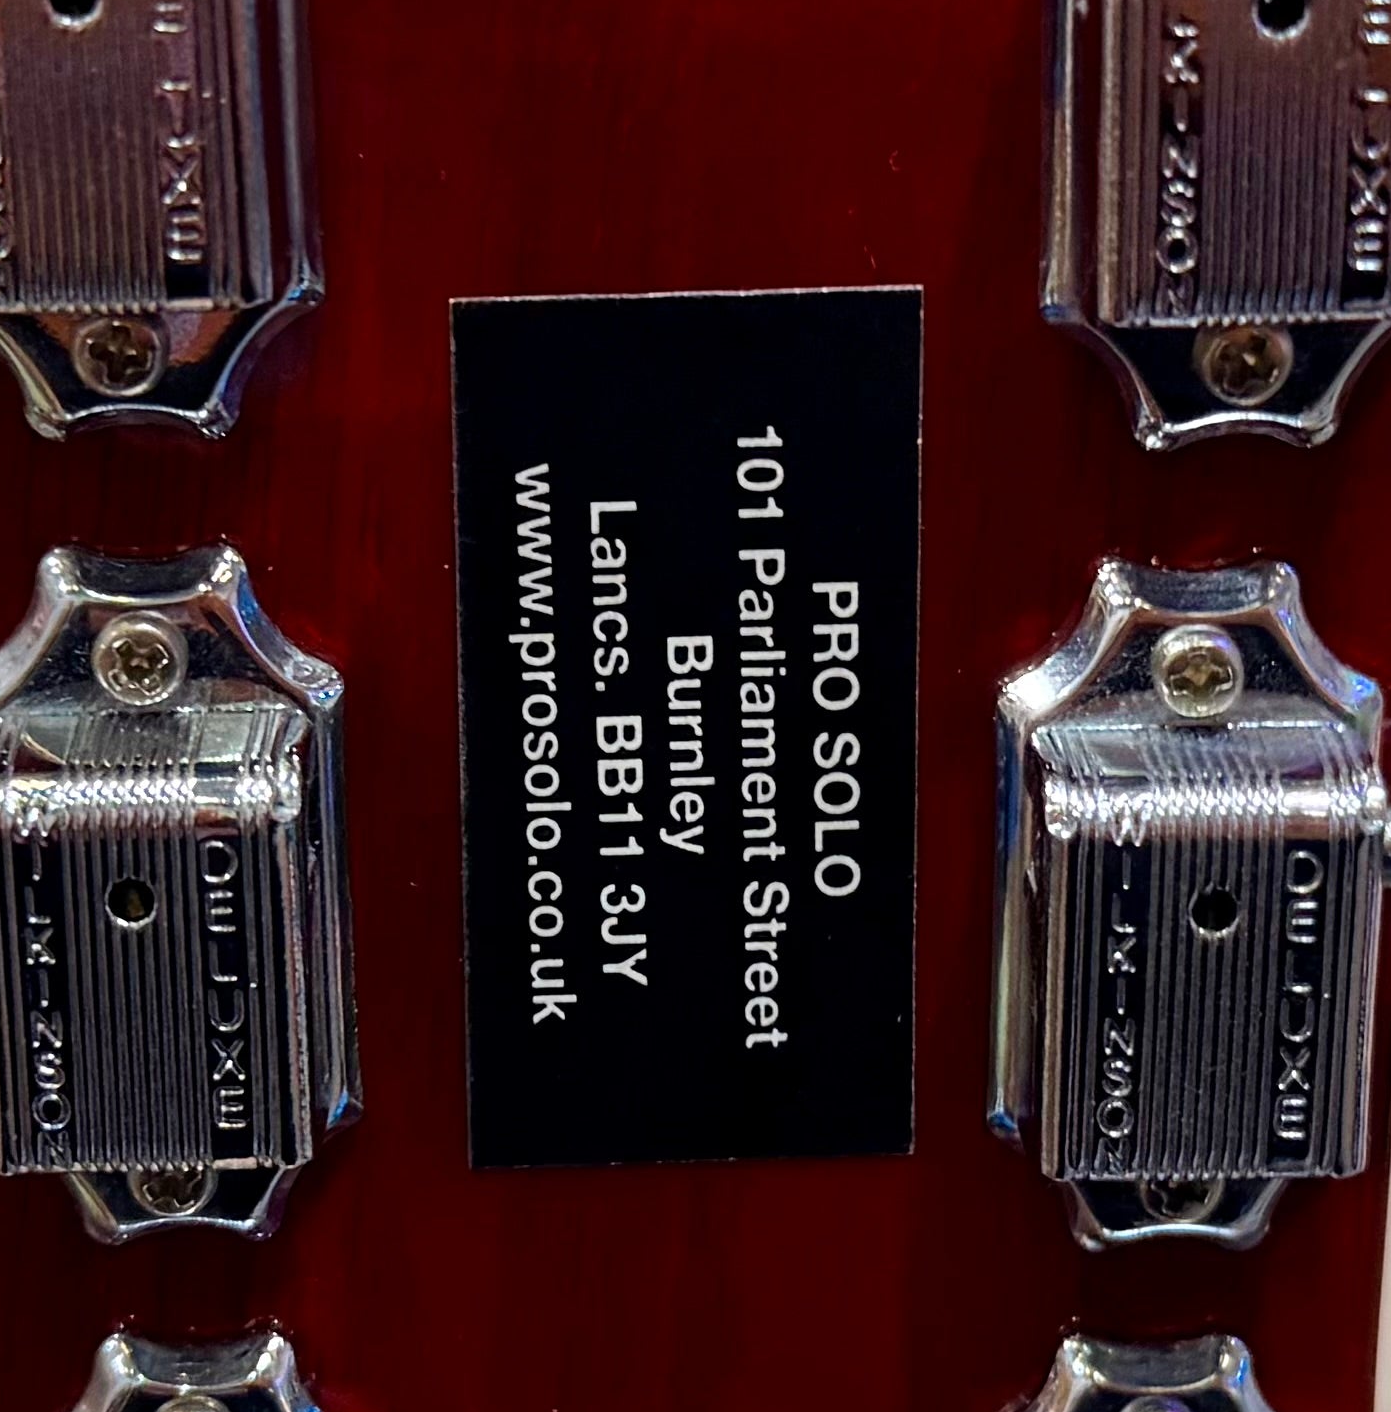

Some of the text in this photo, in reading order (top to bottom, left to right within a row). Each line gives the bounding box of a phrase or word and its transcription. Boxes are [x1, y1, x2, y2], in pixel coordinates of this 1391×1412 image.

[509, 463, 577, 1024] www.prosolo.co.uk
[590, 501, 647, 985] Lancs. BB11 3JY
[660, 636, 715, 854] Burnley
[737, 426, 789, 1048] 101 Parliament Street
[812, 582, 860, 896] PRO SOLO
[200, 839, 248, 1132] DELUXE
[1273, 850, 1325, 1142] DELUXE
